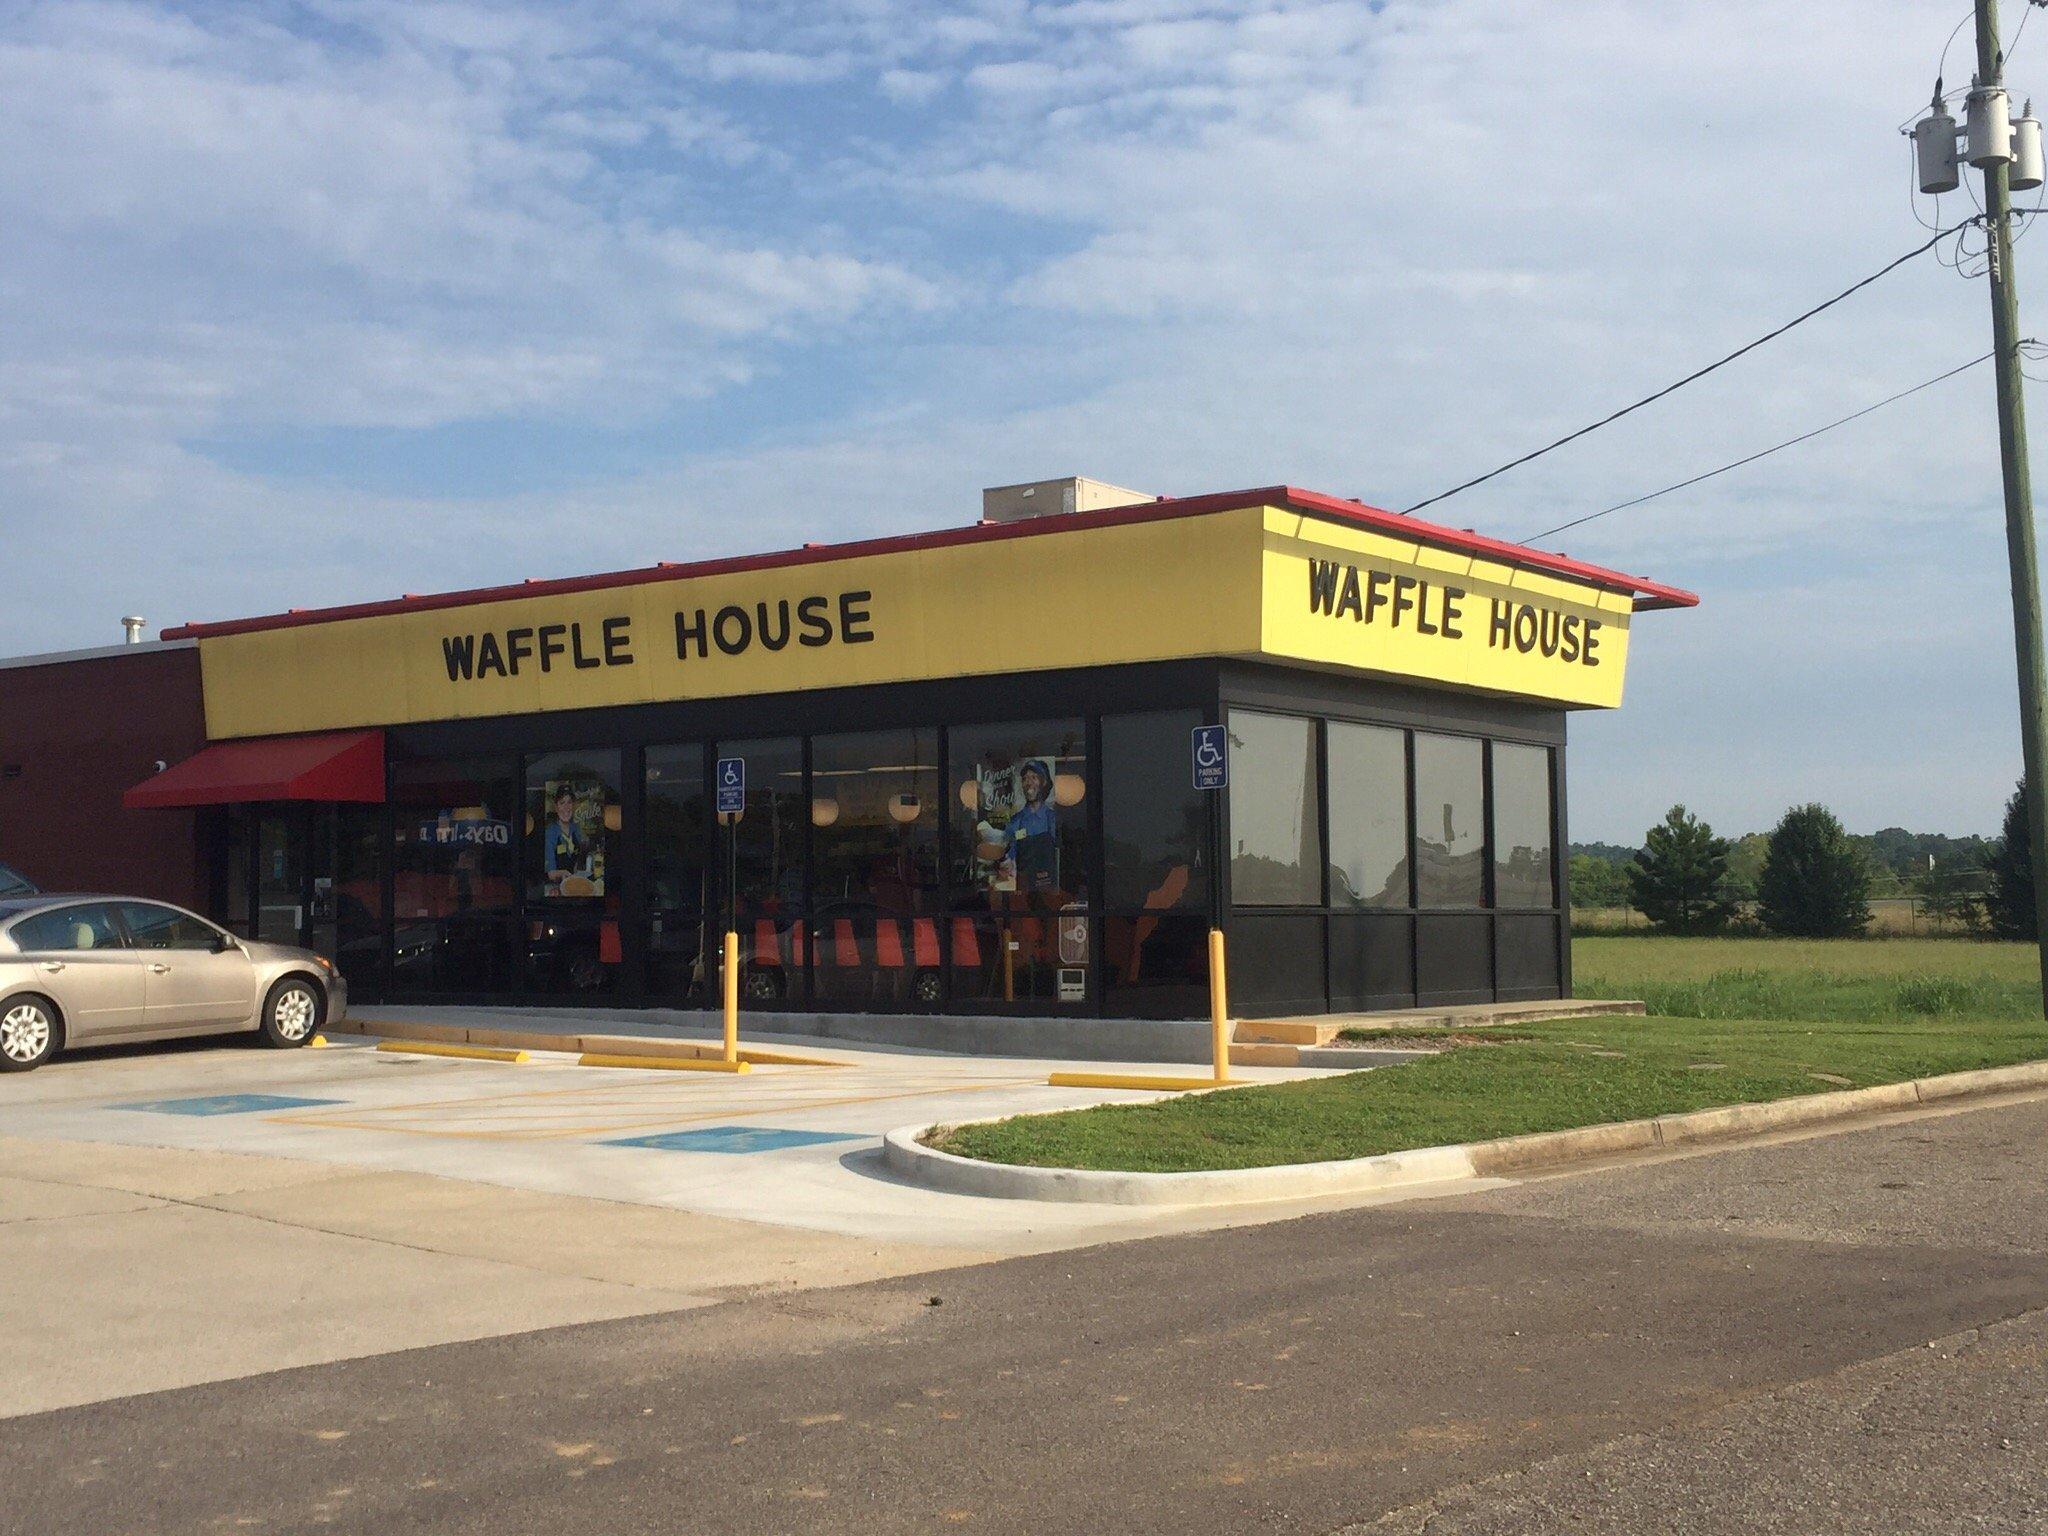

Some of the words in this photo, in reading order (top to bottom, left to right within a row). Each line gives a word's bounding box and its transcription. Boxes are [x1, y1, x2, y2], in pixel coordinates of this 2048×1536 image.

[442, 616, 634, 682] WAFFLE
[674, 590, 874, 660] HOUSE
[1309, 557, 1466, 639] WAFFLE
[1489, 597, 1602, 667] HOUSE
[1198, 767, 1222, 776] PARKING
[1203, 776, 1219, 785] ONLY
